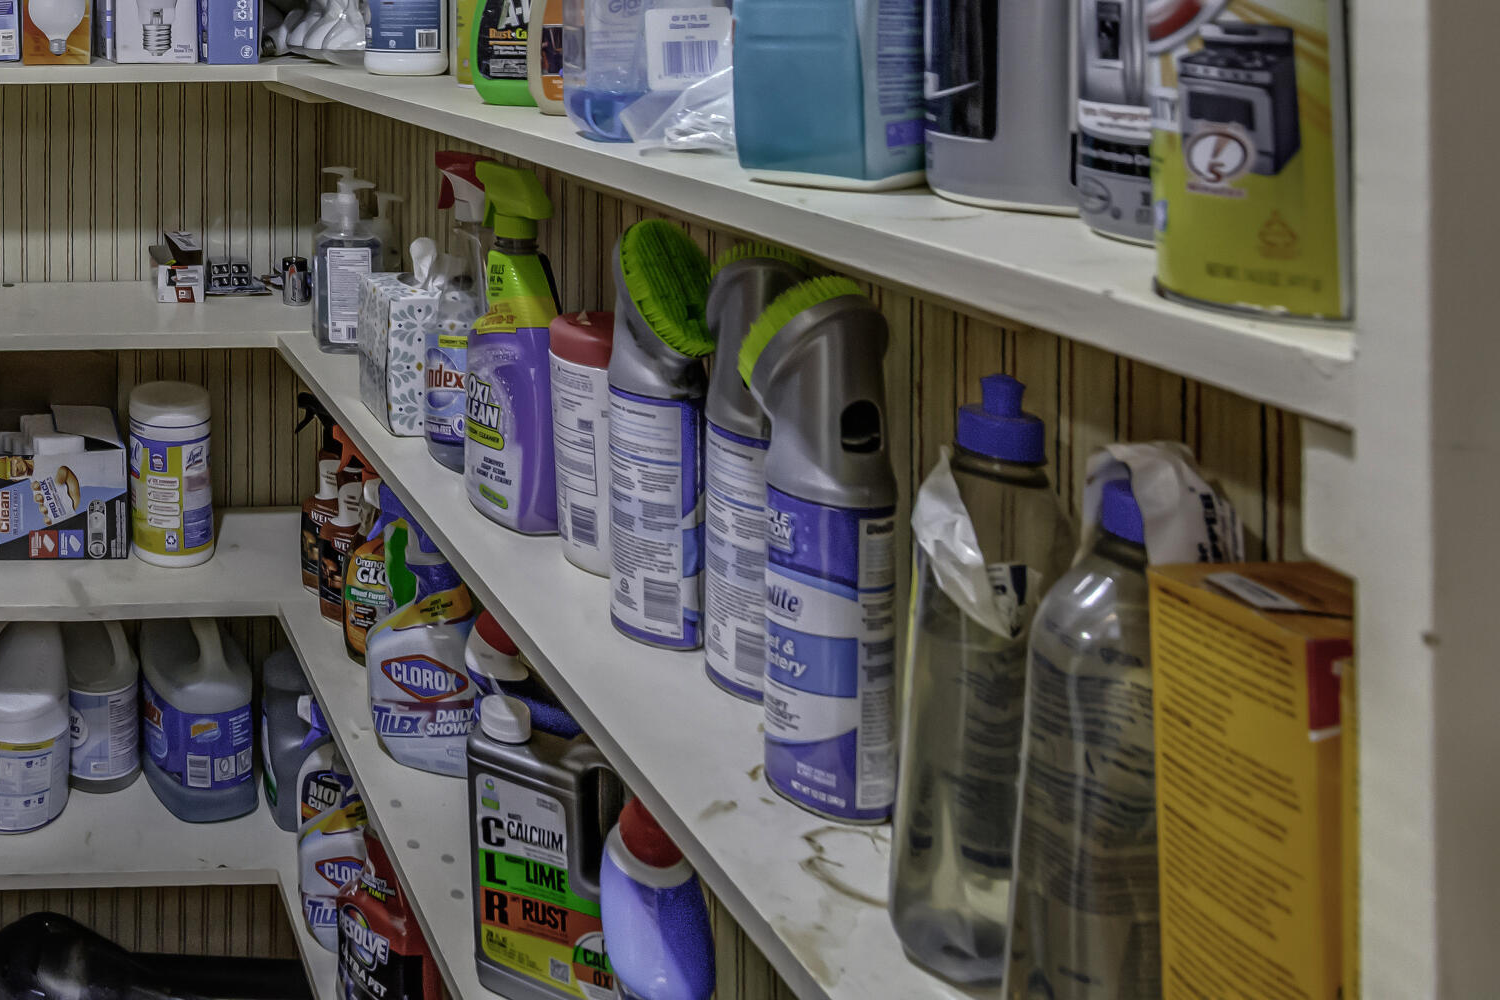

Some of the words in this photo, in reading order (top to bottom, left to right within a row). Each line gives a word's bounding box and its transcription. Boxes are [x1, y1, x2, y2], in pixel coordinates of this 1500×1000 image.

[242, 46, 252, 57] Hg
[1208, 162, 1225, 182] 5
[490, 263, 505, 275] KILLS
[470, 372, 491, 405] OXI
[478, 430, 500, 444] CLEANER
[40, 479, 53, 502] PACK
[48, 502, 60, 519] PRO
[782, 639, 795, 656] &
[390, 661, 457, 693] CLOROX
[372, 703, 424, 738] TILEX
[435, 707, 475, 723] DAILY
[481, 815, 506, 847] C
[507, 819, 564, 852] CALCIUM
[485, 851, 507, 886] L
[525, 859, 566, 893] LIME
[368, 887, 386, 901] TIME
[485, 888, 509, 925] R
[522, 900, 568, 932] RUST
[368, 978, 387, 997] PET
